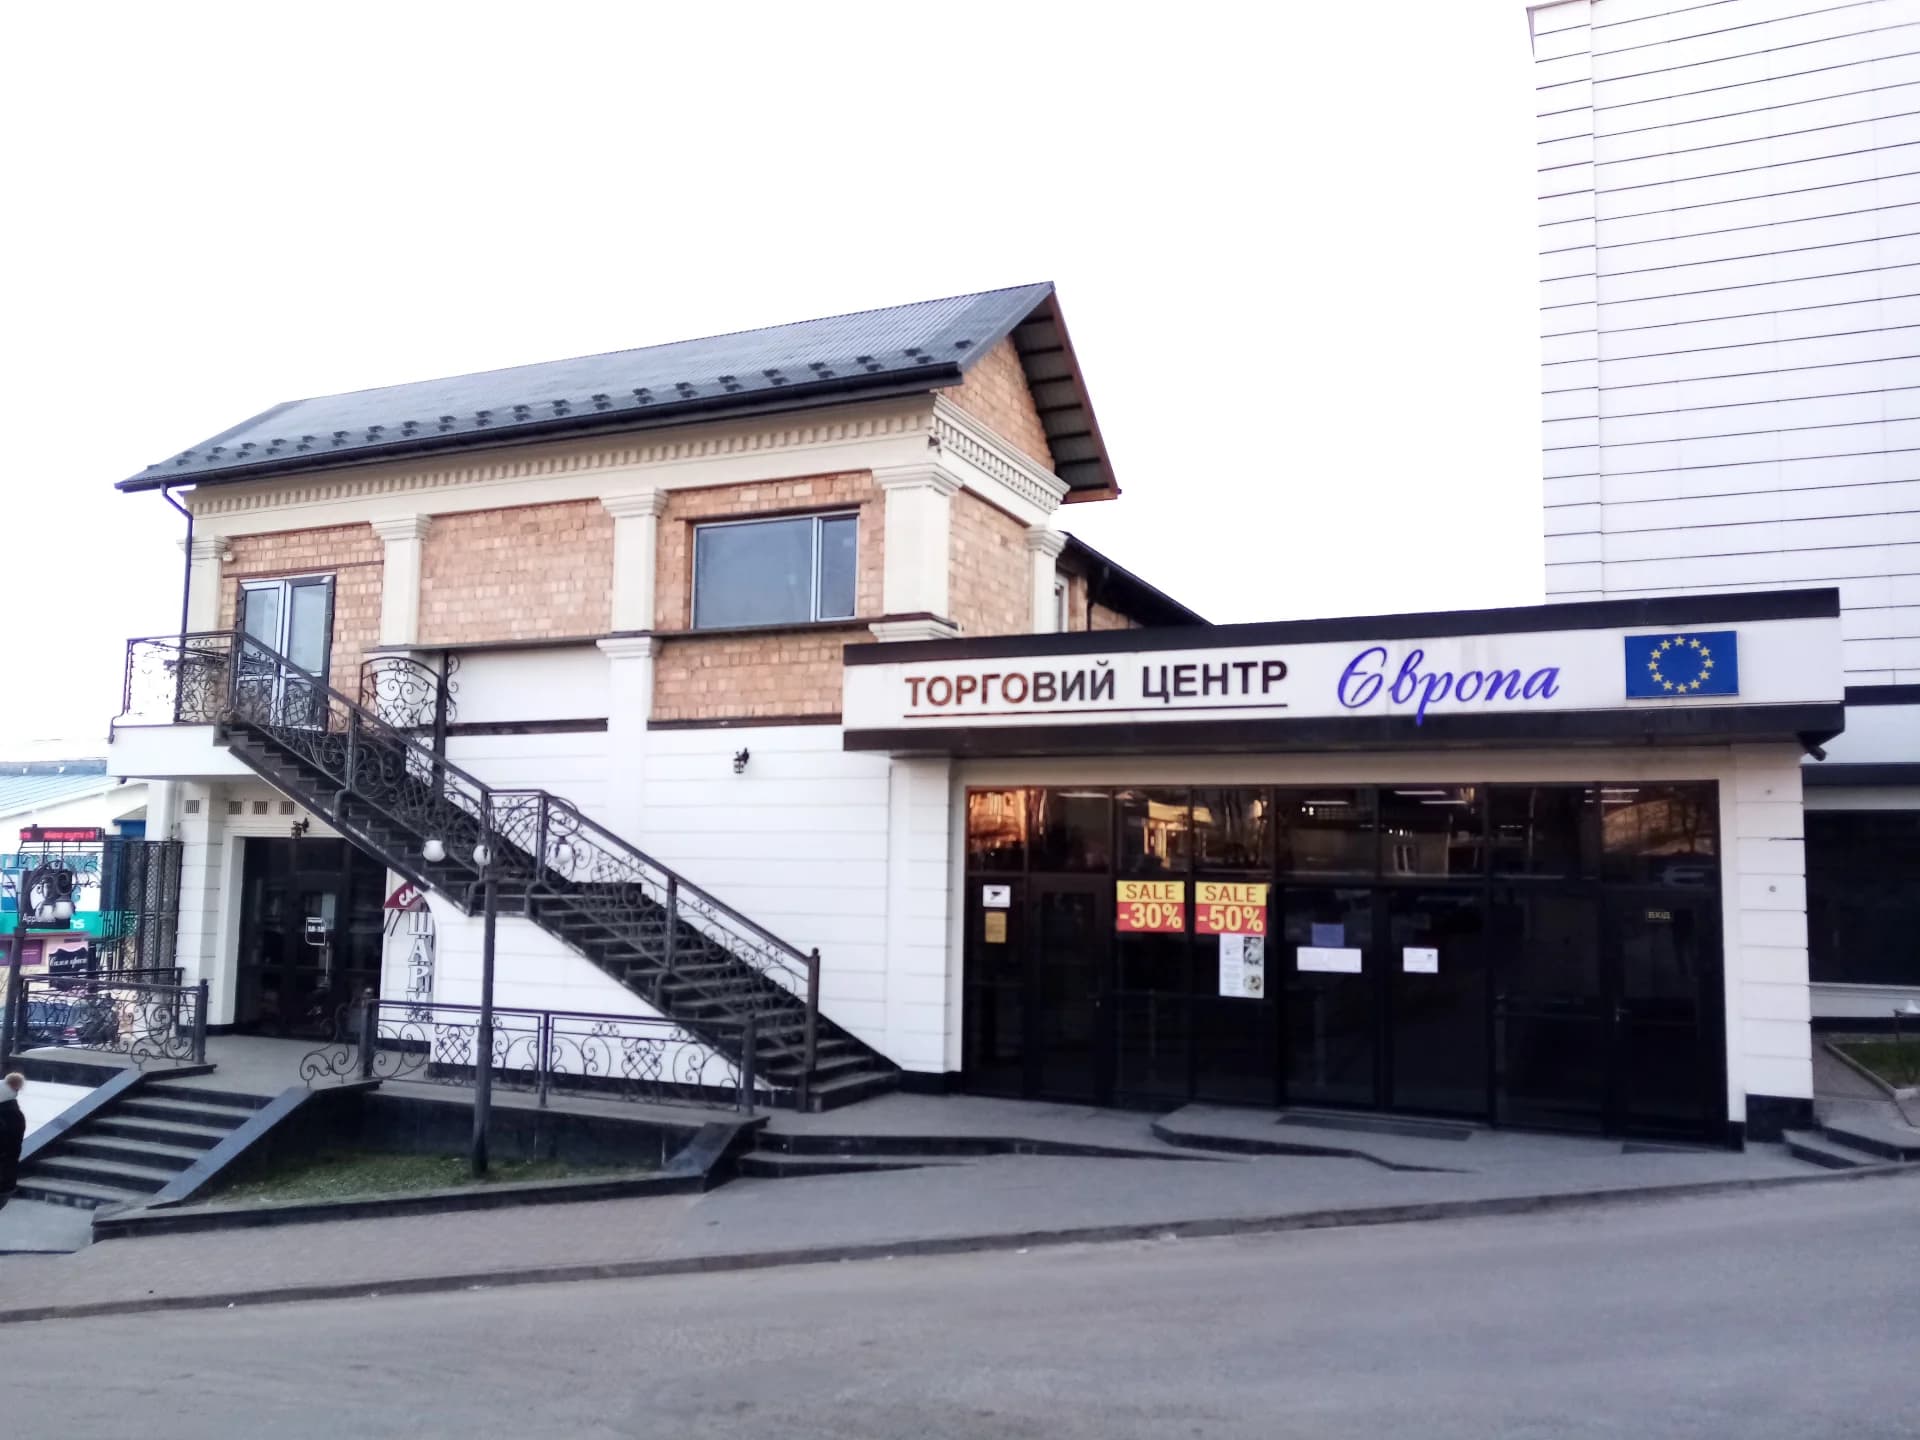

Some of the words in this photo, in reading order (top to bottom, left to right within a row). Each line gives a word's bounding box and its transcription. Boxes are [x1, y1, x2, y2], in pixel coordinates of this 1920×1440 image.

[904, 660, 1115, 707] ТОРГОВИЙ
[1142, 660, 1288, 703] ЦЕНТР
[1336, 646, 1561, 727] Європа
[1126, 883, 1176, 900] SALE
[1205, 885, 1257, 902] SALE
[1119, 903, 1183, 929] -30%
[1197, 905, 1264, 932] -50%
